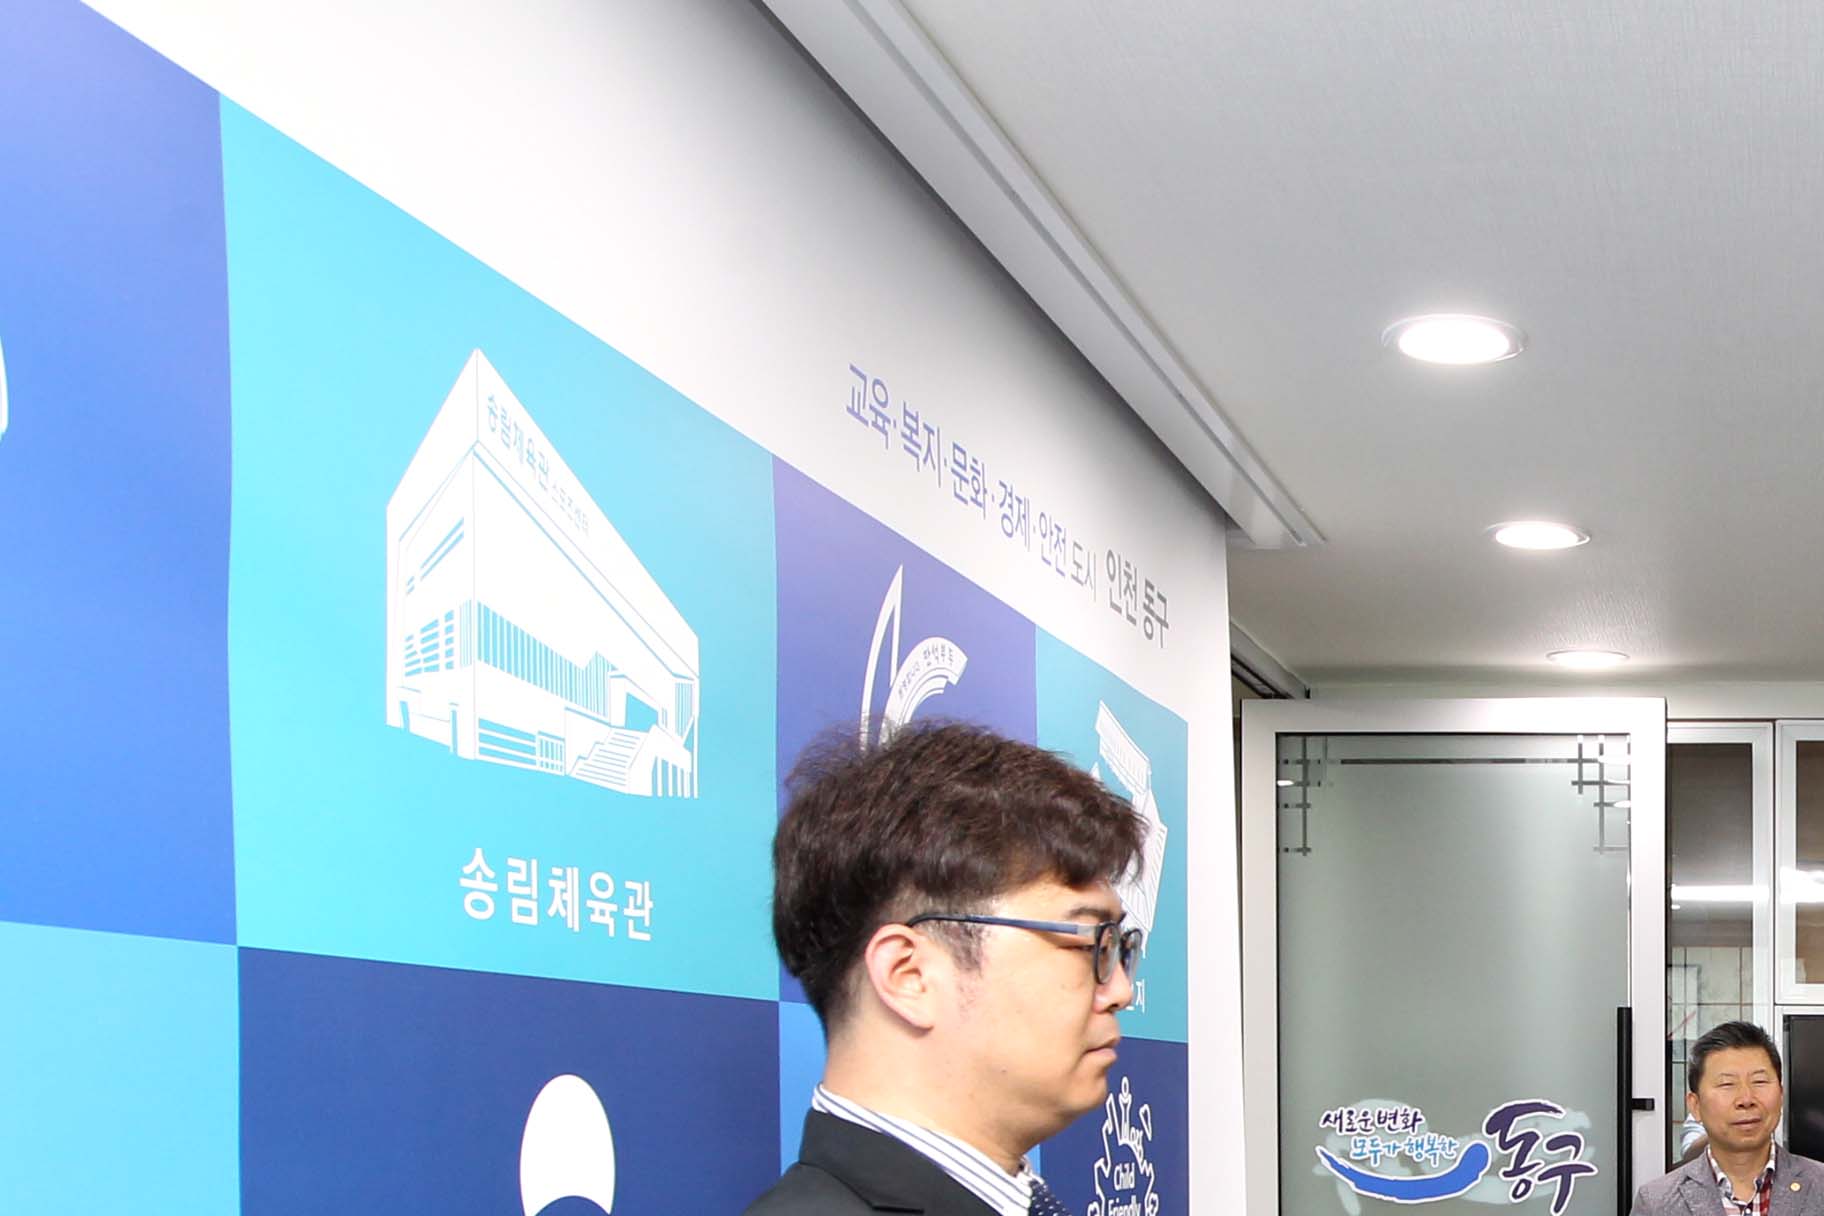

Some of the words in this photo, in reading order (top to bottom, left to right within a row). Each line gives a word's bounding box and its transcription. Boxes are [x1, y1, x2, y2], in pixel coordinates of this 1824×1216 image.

[1071, 540, 1097, 603] 도시
[1106, 549, 1137, 626] 인천
[1143, 577, 1170, 649] 동구
[459, 847, 654, 942] 송림체육관
[1319, 1108, 1372, 1134] 새로운
[1375, 1107, 1424, 1134] 변화
[1352, 1136, 1401, 1167] 모두가
[1404, 1136, 1458, 1167] 행복한
[1113, 1162, 1136, 1192] Child
[1484, 1100, 1597, 1215] 동구
